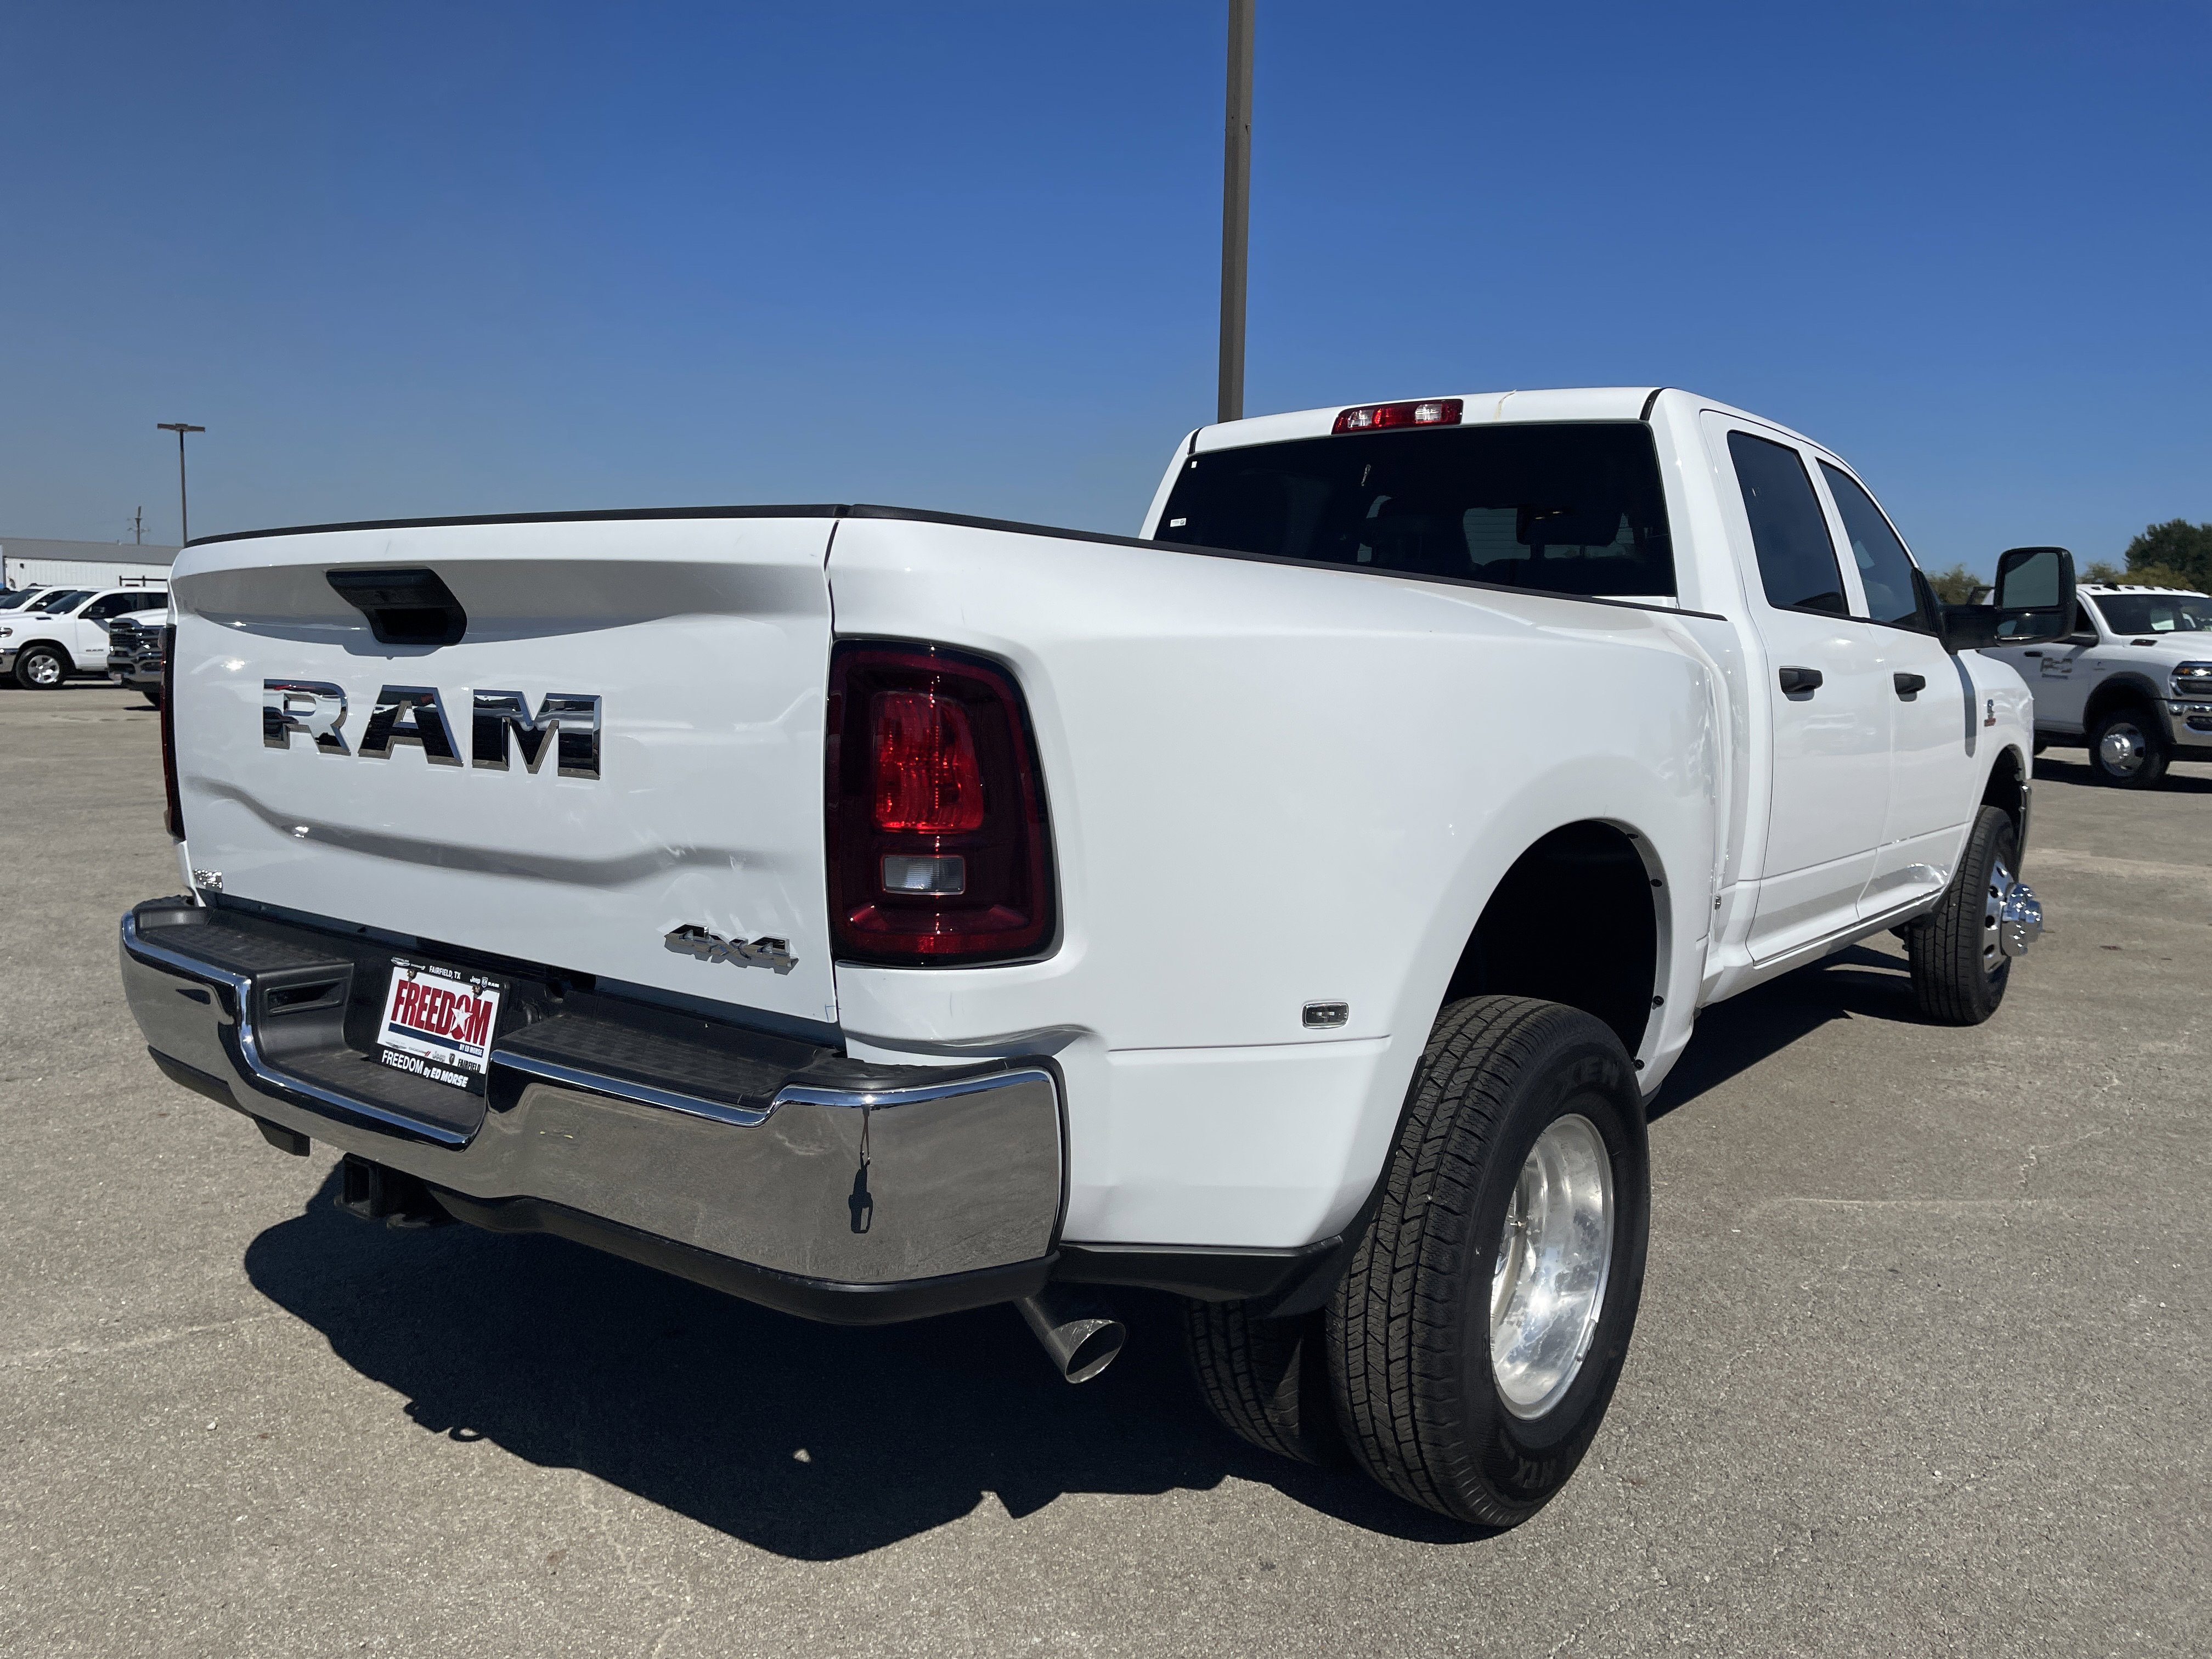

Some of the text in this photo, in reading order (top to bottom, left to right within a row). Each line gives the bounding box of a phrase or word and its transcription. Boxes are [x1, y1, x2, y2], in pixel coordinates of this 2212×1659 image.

[263, 679, 601, 780] RAM
[454, 971, 461, 980] TX
[470, 975, 481, 984] Jeep
[391, 979, 493, 1046] FREEDOM
[381, 1049, 424, 1075] FREEDOM
[430, 1067, 442, 1080] ED
[440, 1070, 469, 1088] MORSE
